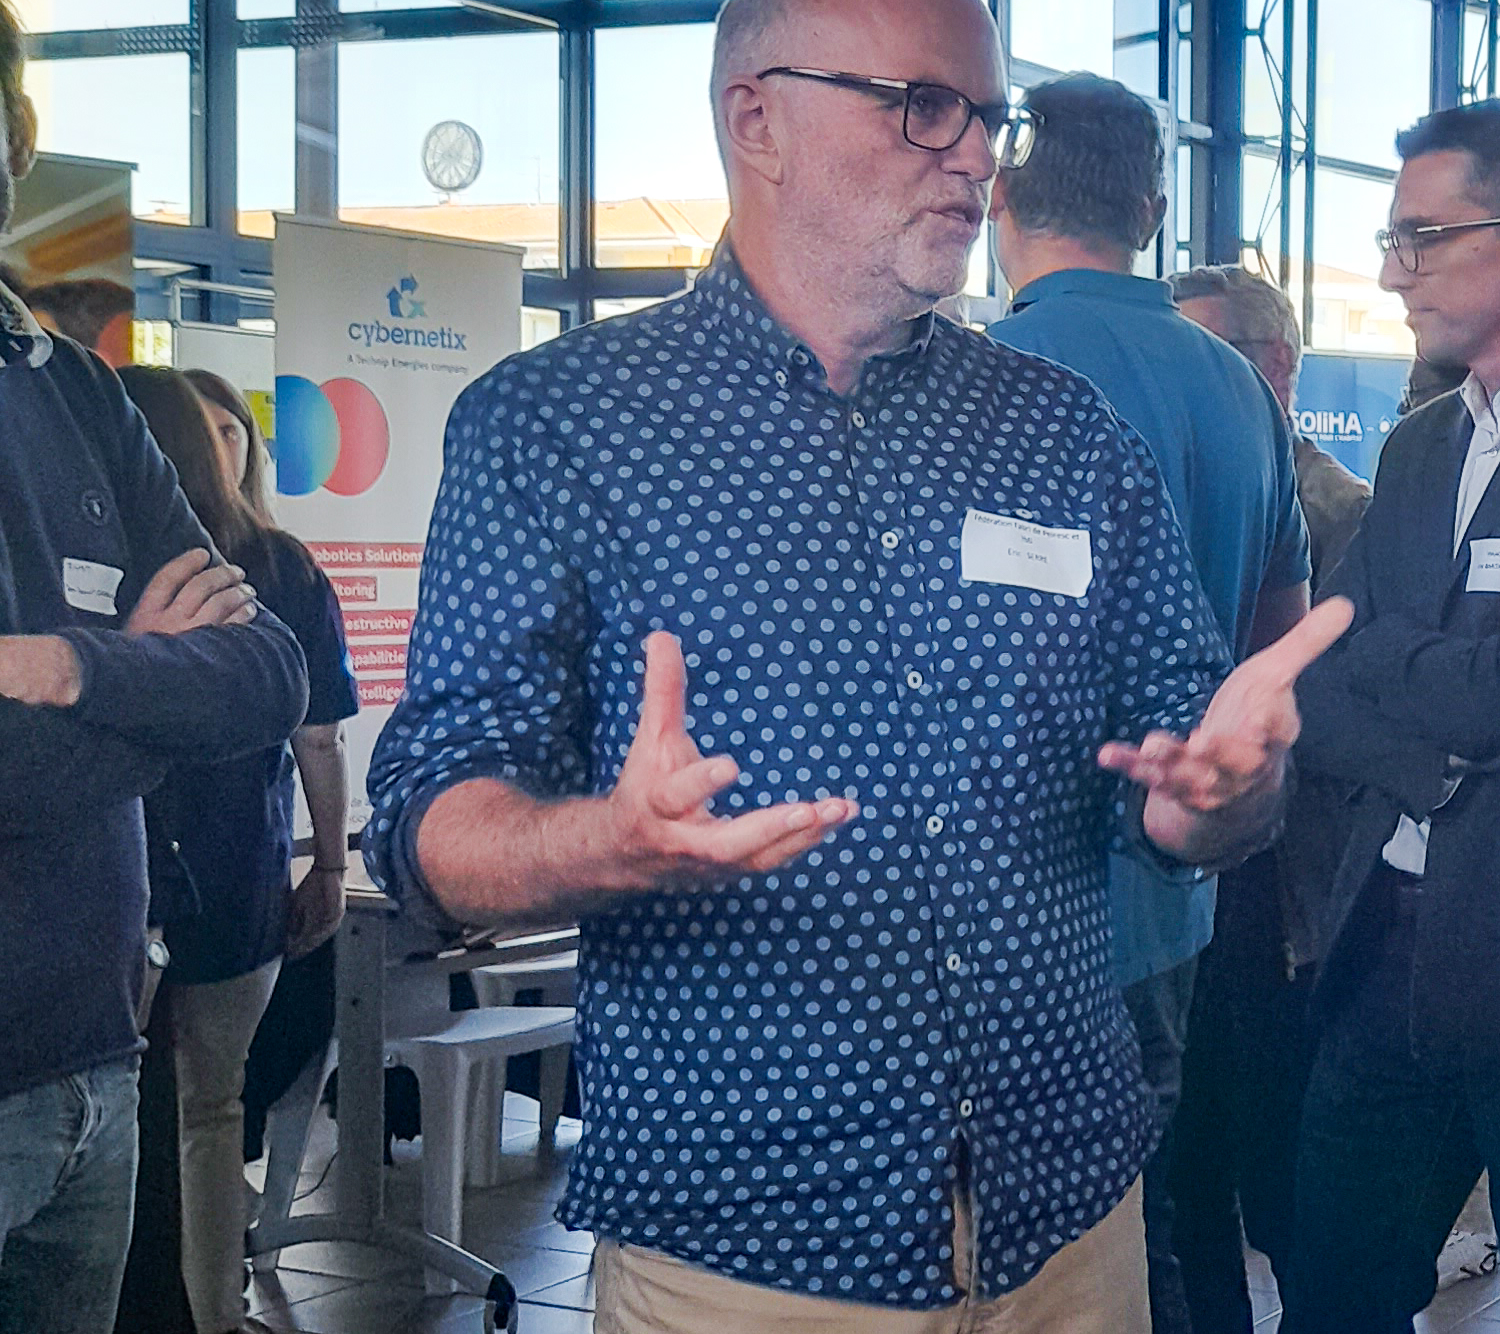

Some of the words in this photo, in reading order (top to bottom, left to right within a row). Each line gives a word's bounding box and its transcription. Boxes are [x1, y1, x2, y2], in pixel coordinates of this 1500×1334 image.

[348, 320, 467, 351] cybernetix
[313, 548, 363, 562] obotics
[333, 582, 375, 600] itoring
[345, 615, 409, 630] estructive
[352, 651, 405, 668] pabilitie
